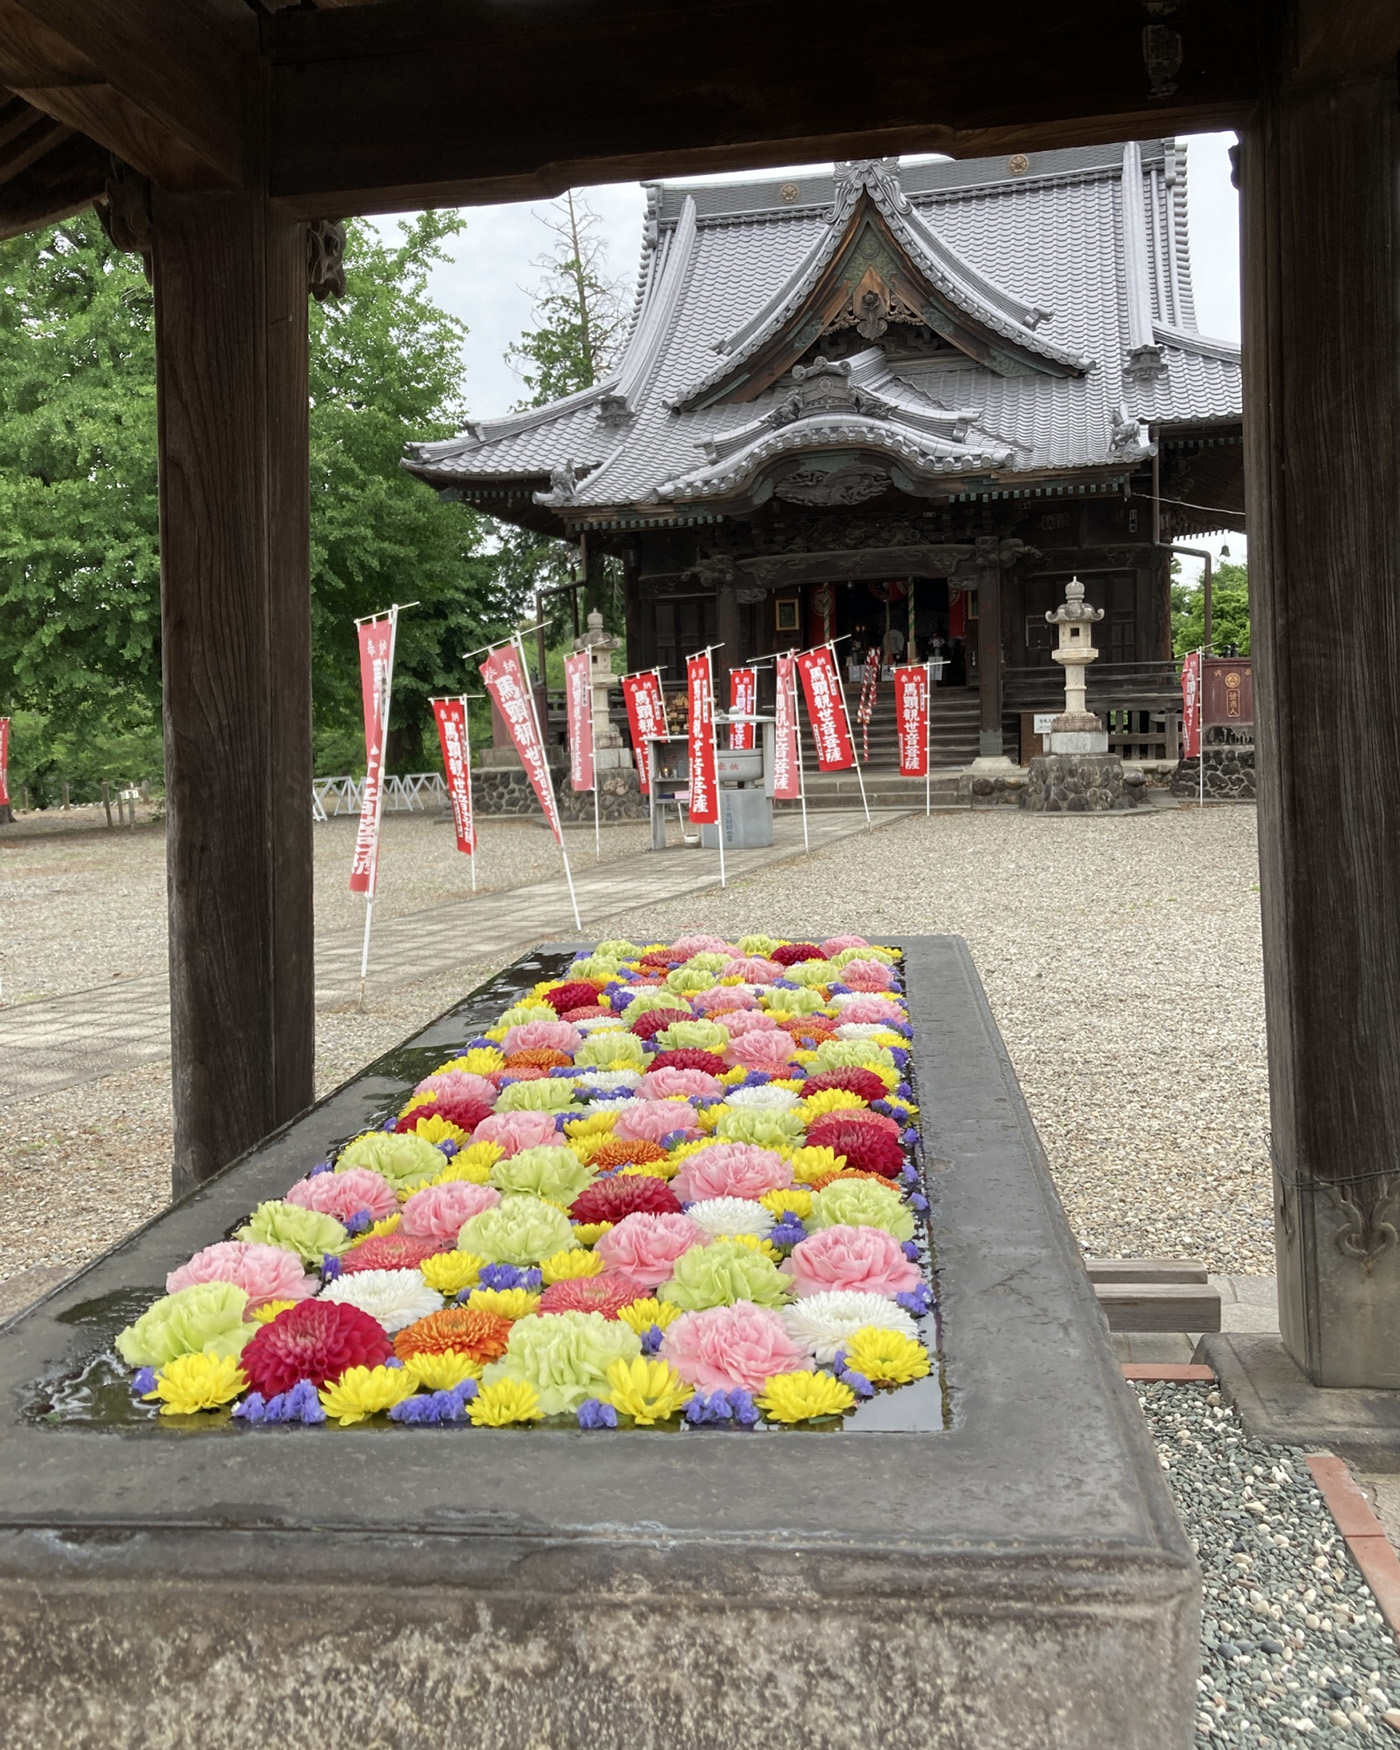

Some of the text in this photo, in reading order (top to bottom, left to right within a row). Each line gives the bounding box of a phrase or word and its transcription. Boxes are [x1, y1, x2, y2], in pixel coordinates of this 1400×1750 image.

[804, 657, 826, 668] 奉納
[900, 675, 922, 683] 奉納
[630, 682, 652, 692] 奉納
[440, 709, 460, 721] 奉納
[809, 667, 842, 763] 馬頭観世音菩薩
[903, 683, 920, 770] 馬頭観世音菩薩
